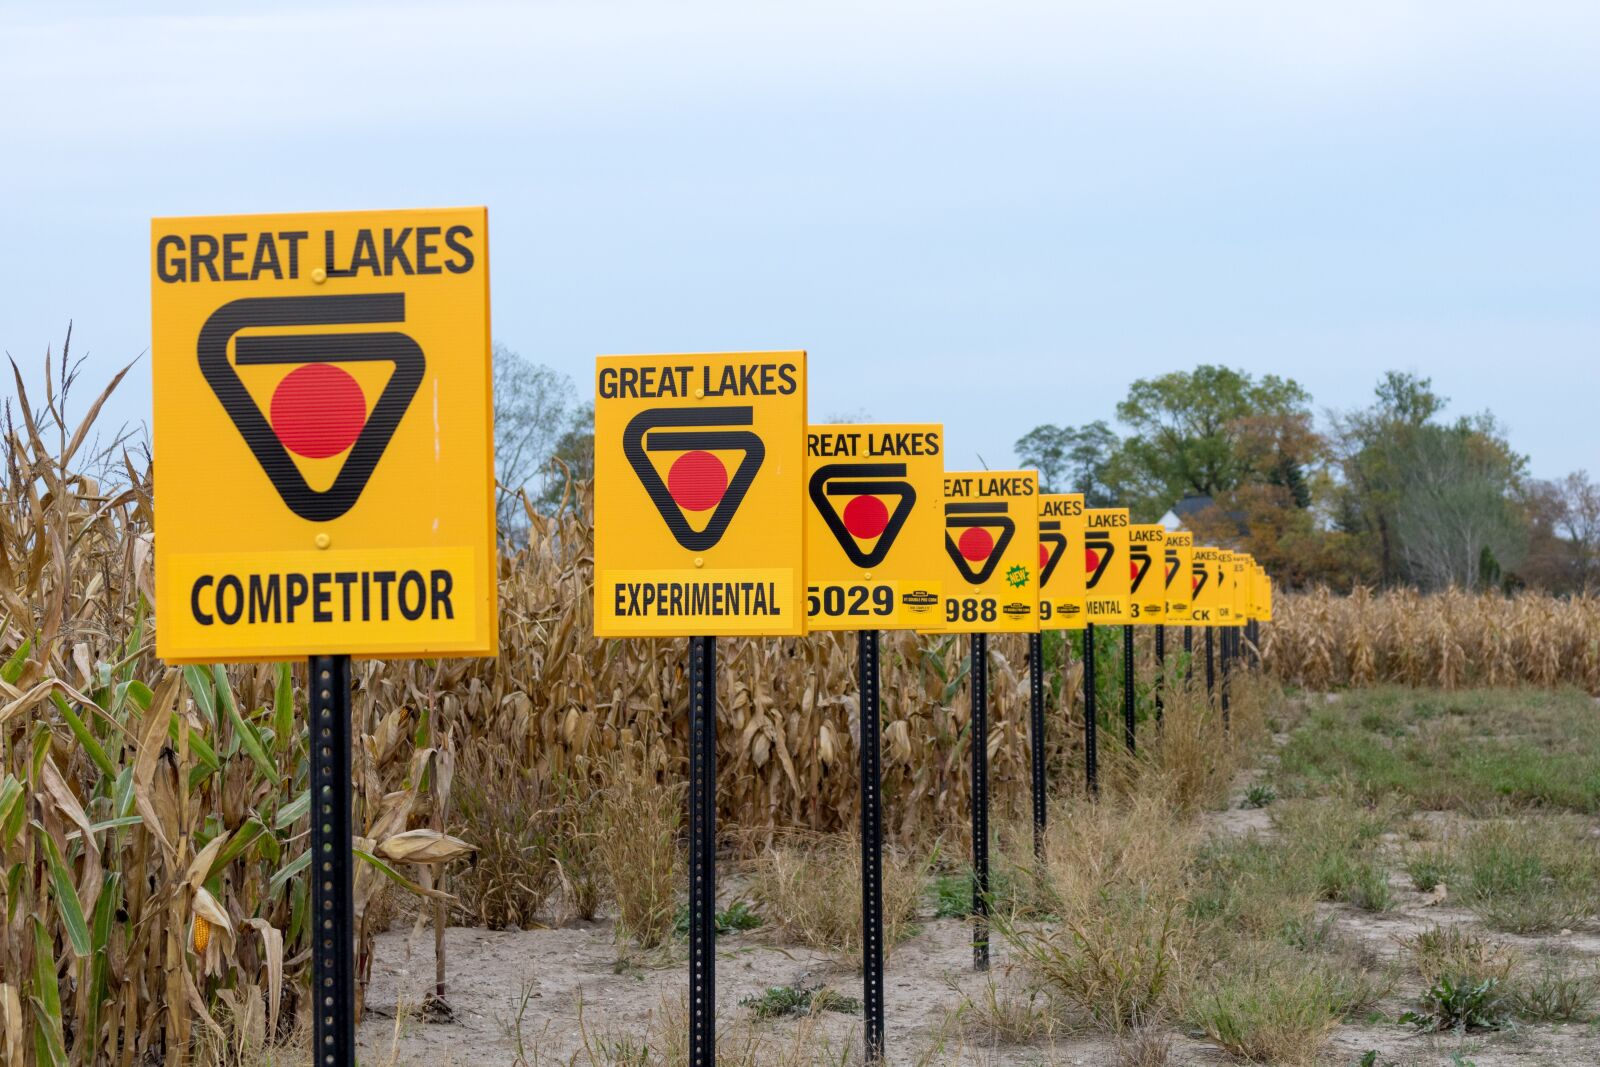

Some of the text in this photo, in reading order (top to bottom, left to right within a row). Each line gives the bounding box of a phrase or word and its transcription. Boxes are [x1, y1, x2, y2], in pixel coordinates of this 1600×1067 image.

[156, 225, 474, 283] GREAT LAKES
[599, 363, 797, 399] GREAT LAKES
[808, 433, 939, 457] REAT LAKES
[979, 478, 1033, 496] LAKES
[1088, 514, 1127, 527] LAKES
[1129, 530, 1163, 541] LAKES
[1193, 551, 1217, 560] AKES
[1009, 570, 1026, 584] NEW
[190, 569, 454, 626] COMPETITOR
[615, 582, 780, 616] EXPERIMENTAL
[808, 585, 894, 616] 5029
[946, 598, 997, 622] 988
[1040, 600, 1052, 620] 9
[1130, 603, 1140, 618] 3
